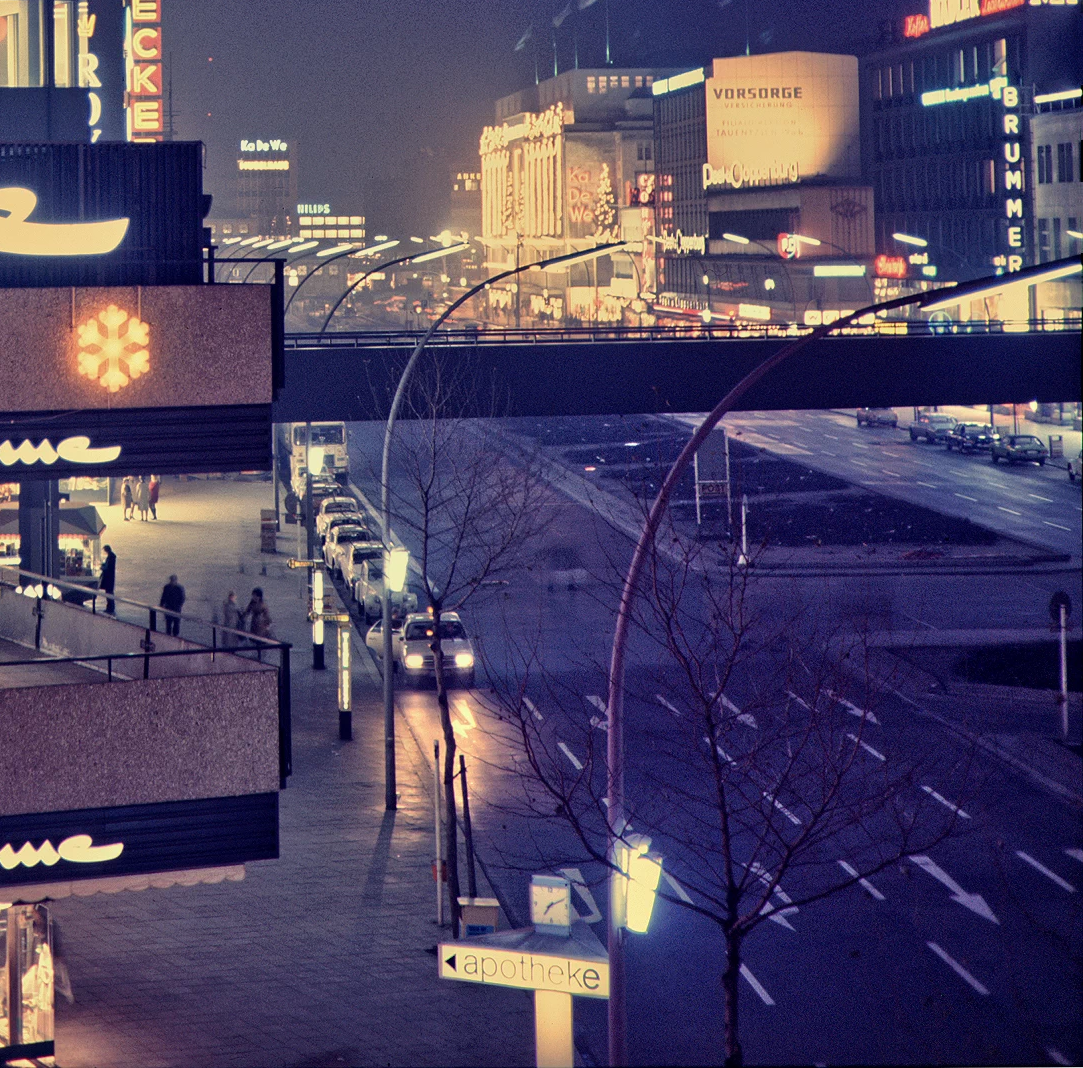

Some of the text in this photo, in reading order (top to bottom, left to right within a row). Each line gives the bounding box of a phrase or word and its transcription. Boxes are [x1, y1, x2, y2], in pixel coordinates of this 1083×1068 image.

[713, 87, 803, 100] VORSORGE
[724, 101, 793, 109] VERSICHERUNG
[569, 168, 592, 183] Ka
[1003, 86, 1023, 273] BRUMMER
[569, 189, 592, 203] De
[569, 206, 595, 223] We
[463, 953, 601, 991] apotheke
